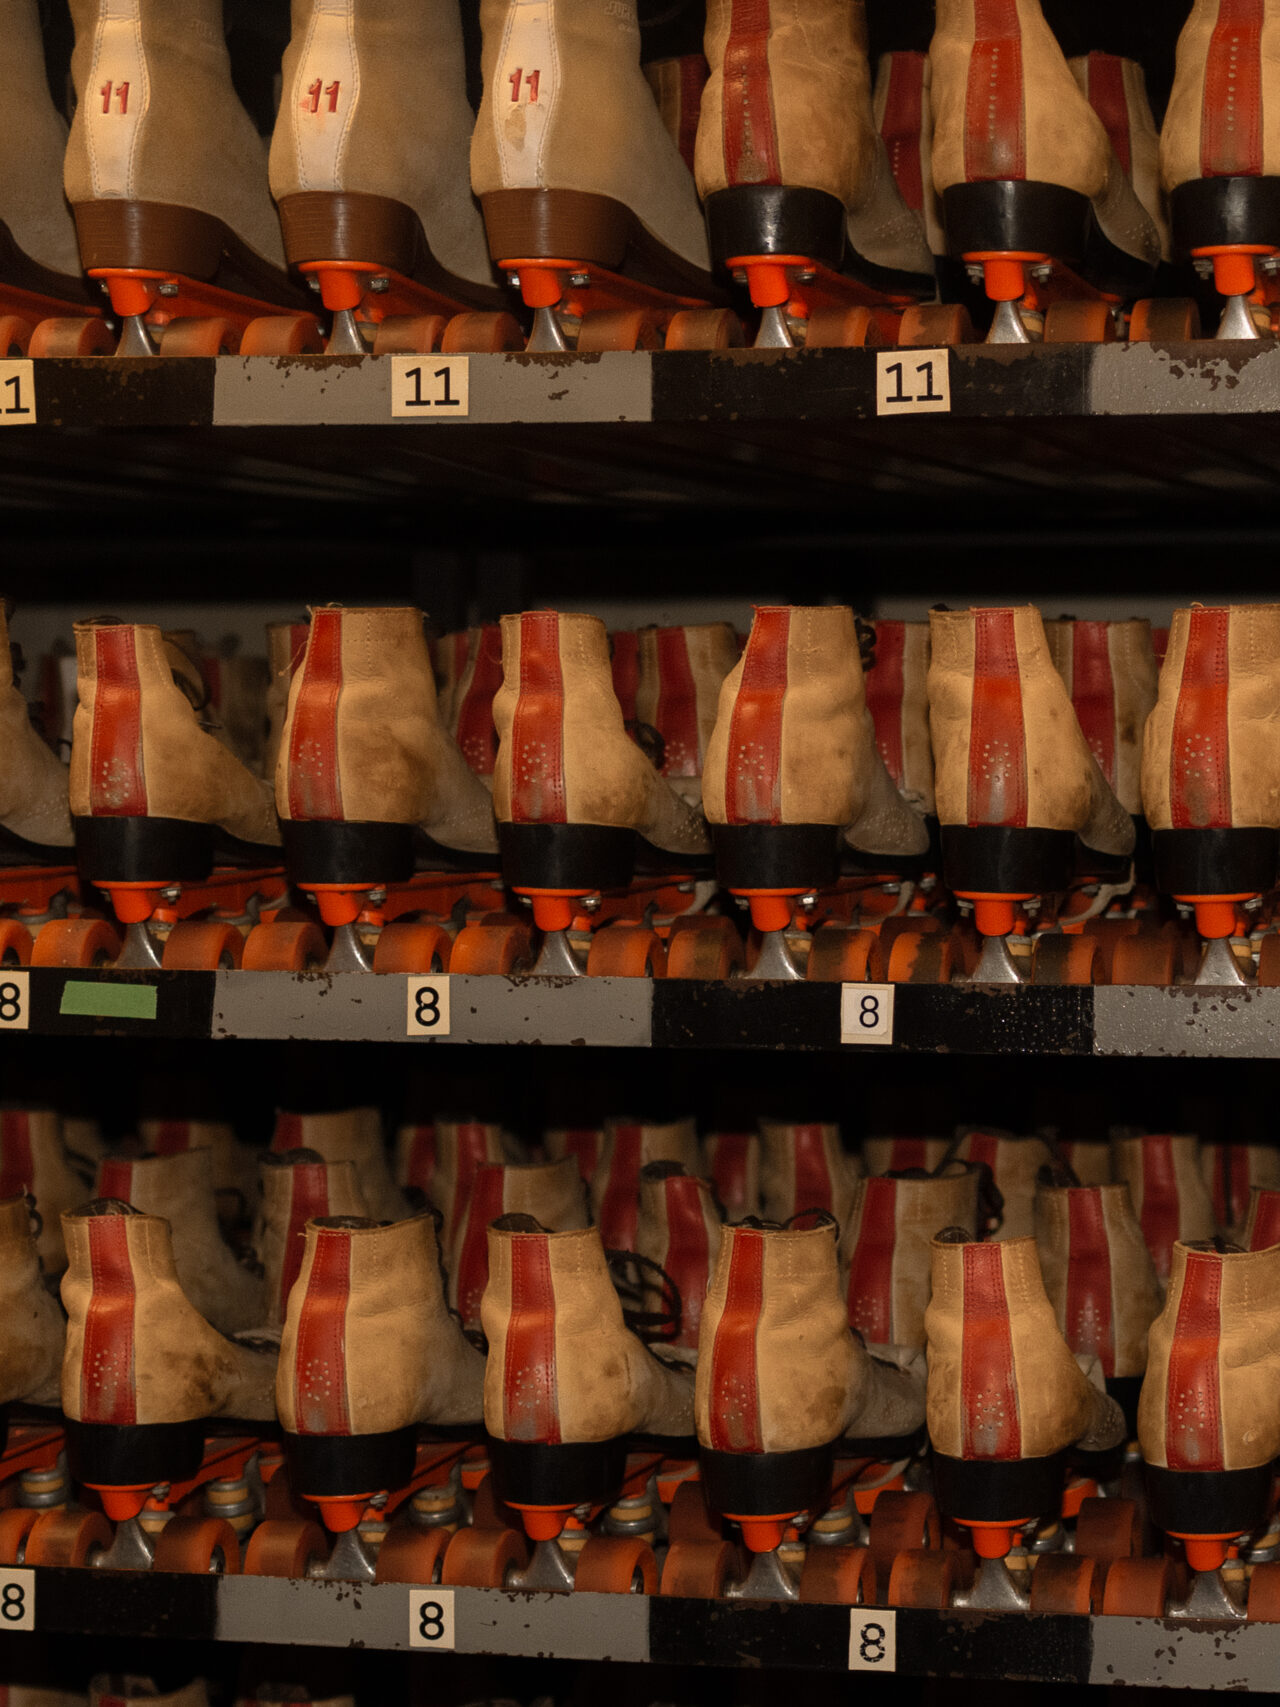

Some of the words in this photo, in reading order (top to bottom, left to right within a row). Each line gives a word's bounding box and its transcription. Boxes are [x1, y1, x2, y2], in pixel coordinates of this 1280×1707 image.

[100, 80, 130, 115] 11
[307, 79, 341, 114] 11
[508, 68, 541, 103] 11
[405, 367, 460, 406] 11
[886, 362, 943, 402] 11
[522, 741, 549, 784] 8
[736, 741, 765, 784] 8
[981, 740, 1013, 782] 8
[1182, 732, 1214, 779] 8
[414, 986, 441, 1027] 8
[859, 994, 880, 1029] 8
[93, 1348, 120, 1391] 8
[304, 1358, 332, 1402] 8
[975, 1388, 1005, 1432] 8
[1177, 1389, 1207, 1433] 8
[0, 1582, 26, 1622] 8
[418, 1600, 445, 1641] 8
[859, 1622, 886, 1664] 8
